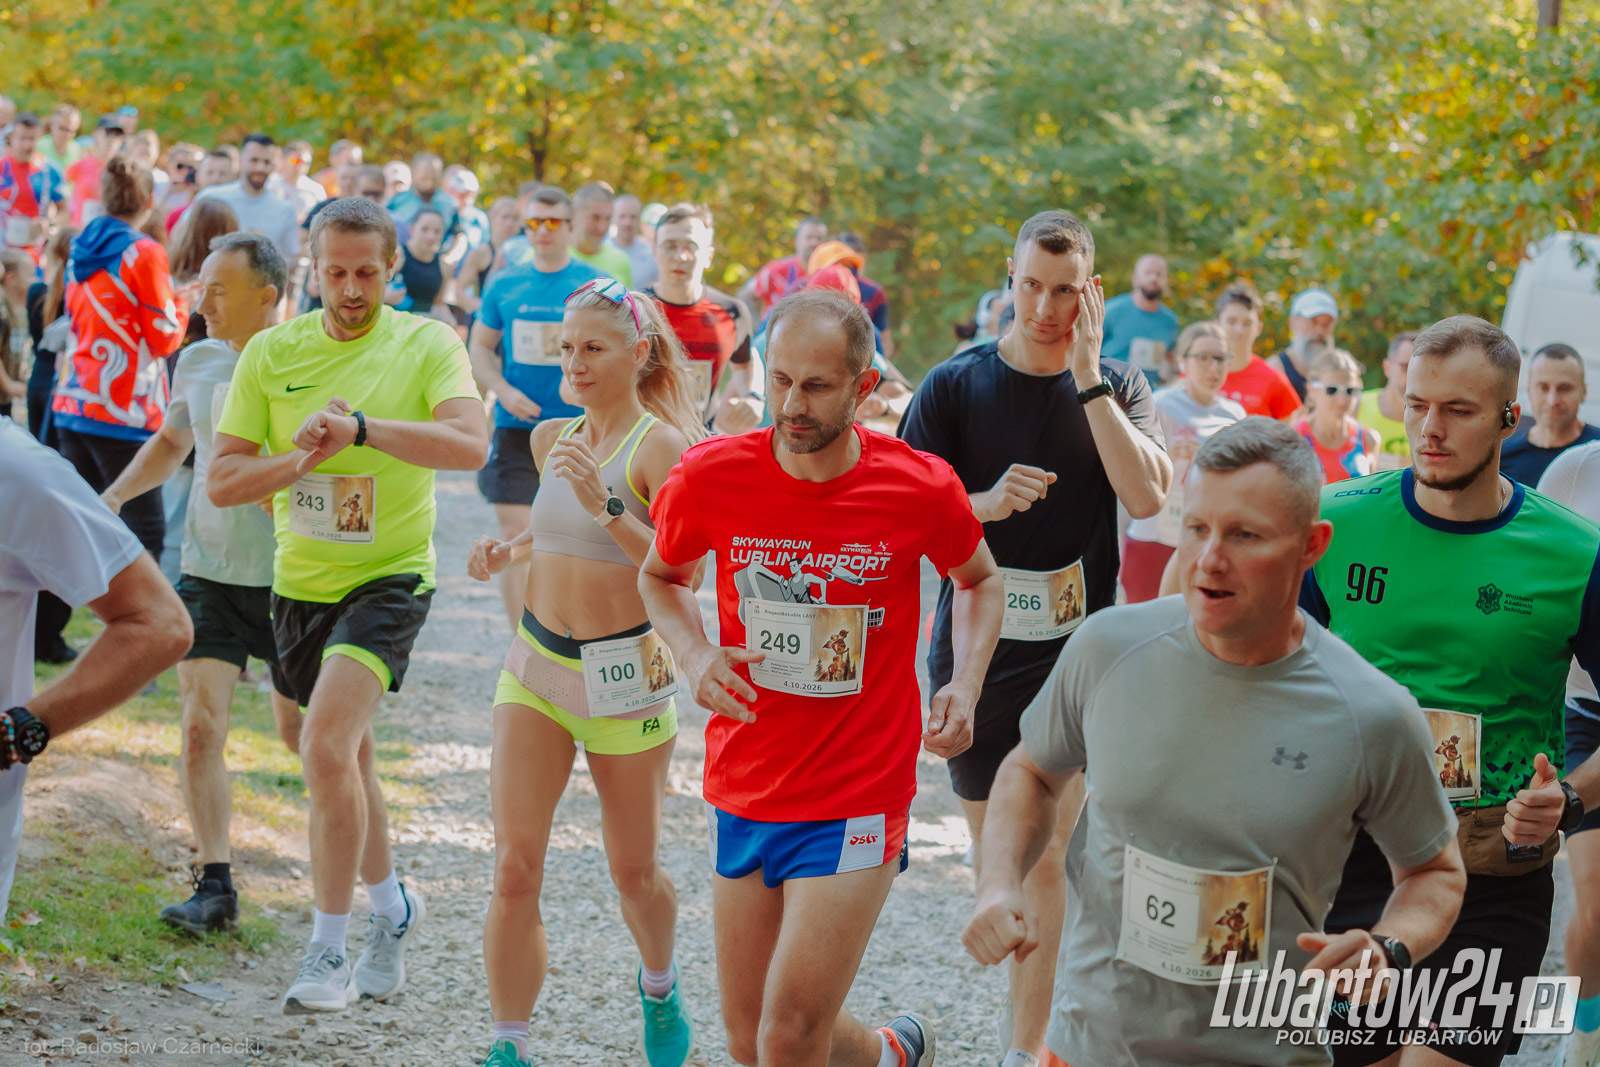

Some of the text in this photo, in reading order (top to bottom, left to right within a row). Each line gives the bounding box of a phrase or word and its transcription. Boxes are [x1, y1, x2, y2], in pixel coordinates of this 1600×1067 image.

[296, 491, 325, 512] 243
[1334, 487, 1383, 498] COLO
[731, 536, 812, 550] SKYWAYRUN
[730, 548, 891, 571] LUBLIN AIRPORT
[1345, 562, 1389, 605] 96
[1007, 592, 1042, 611] 266
[760, 629, 801, 655] 249
[598, 662, 635, 684] 100
[783, 681, 823, 692] 4.10.2026
[642, 716, 660, 734] FA
[1146, 893, 1176, 928] 62
